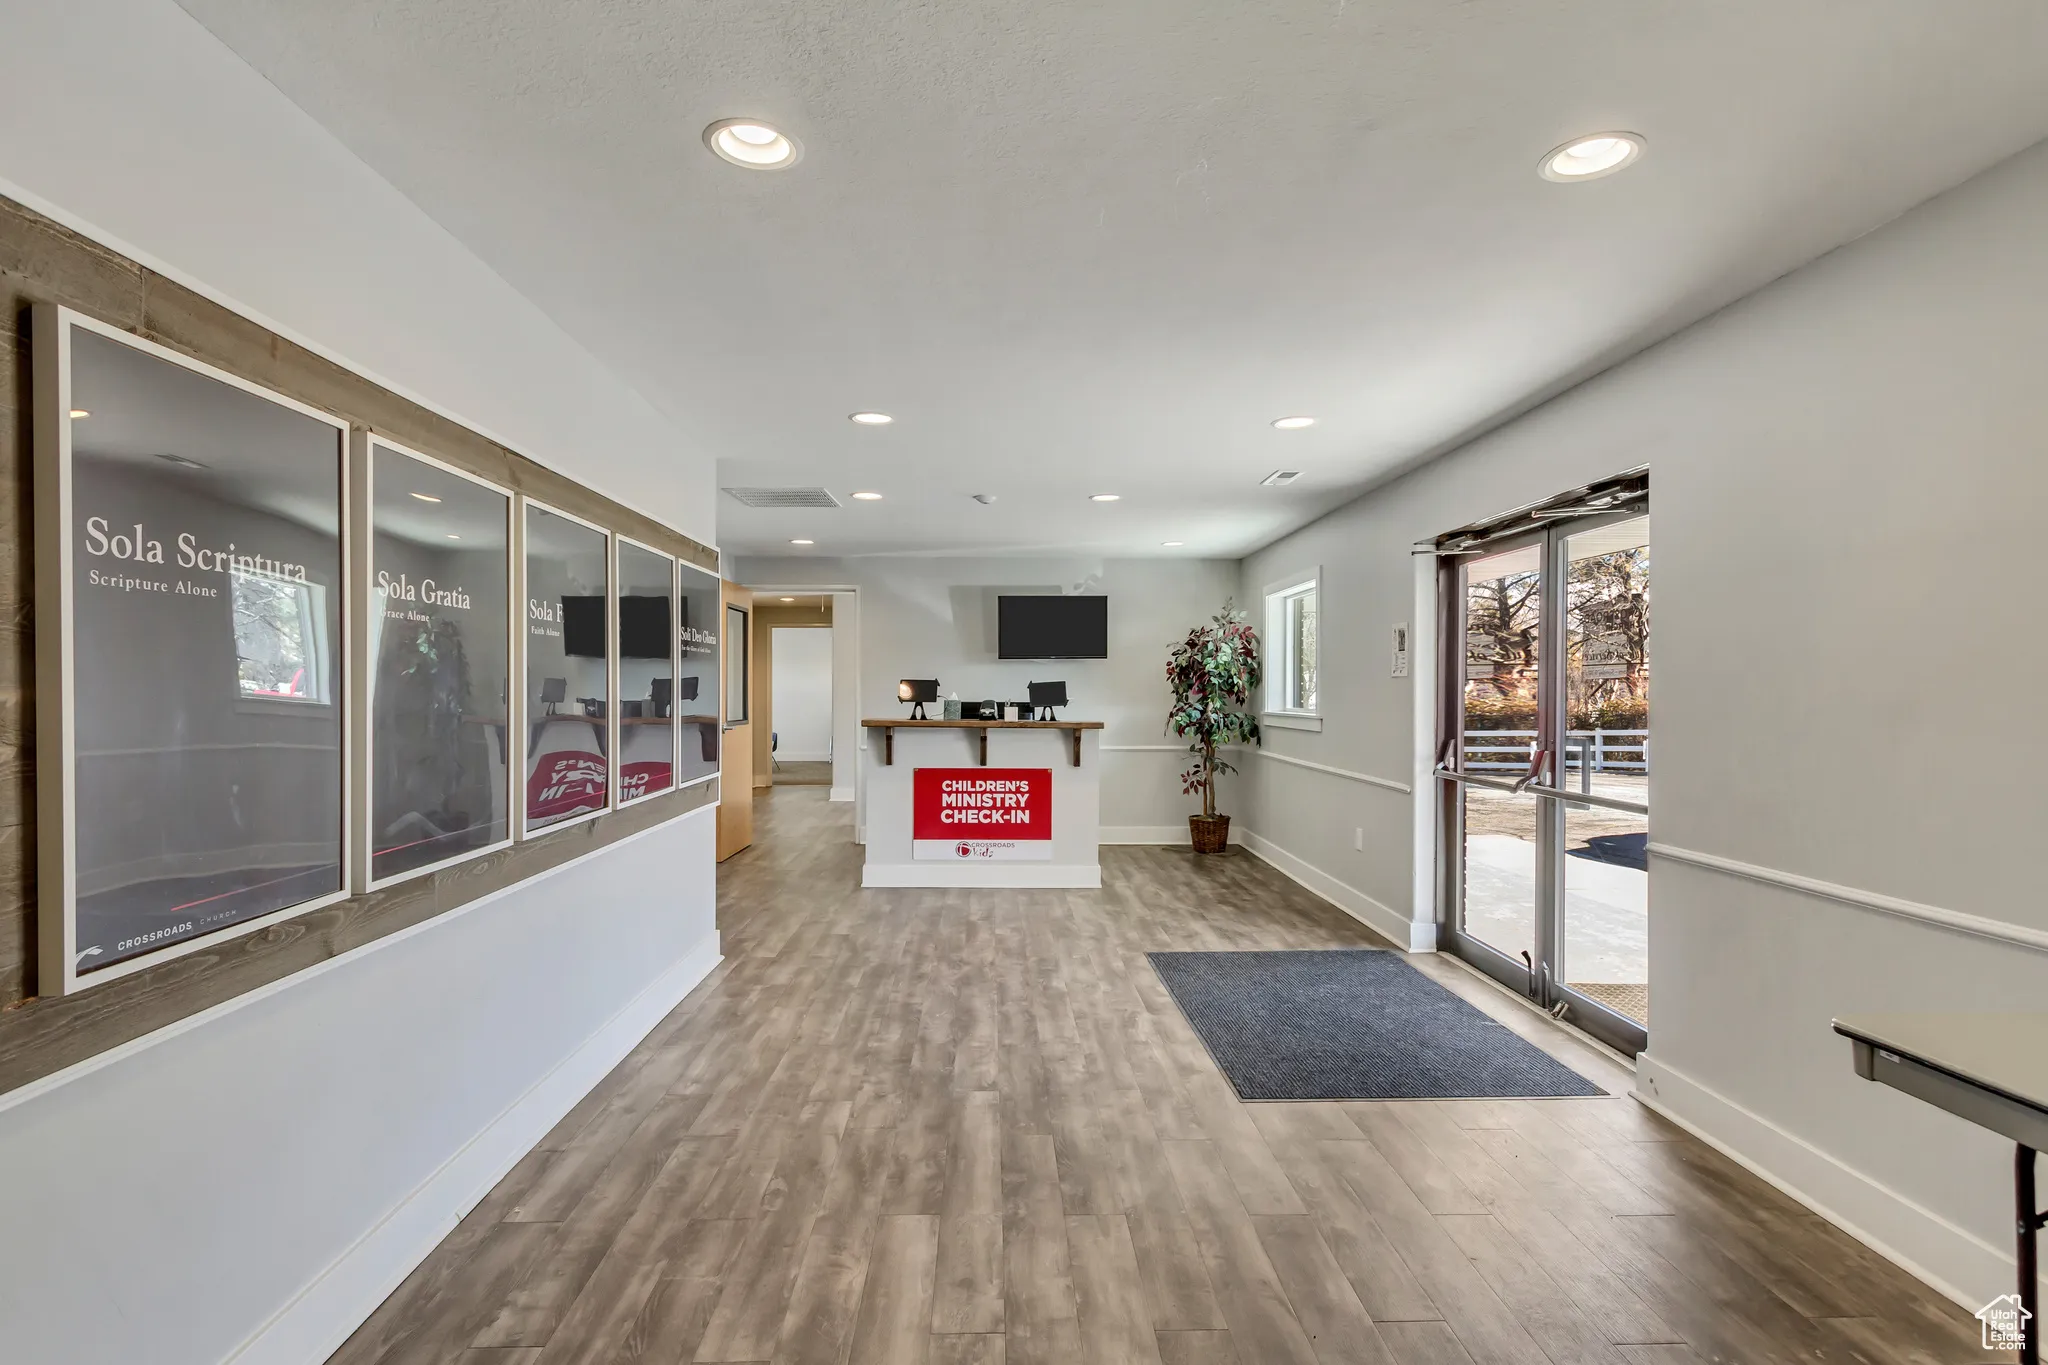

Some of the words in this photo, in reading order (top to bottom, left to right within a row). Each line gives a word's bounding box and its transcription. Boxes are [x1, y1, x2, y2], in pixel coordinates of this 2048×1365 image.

[85, 516, 164, 564] Sola
[176, 532, 306, 584] Scriptura
[89, 569, 168, 592] Scripture
[175, 580, 217, 597] Alone
[378, 570, 416, 602] Sola
[421, 579, 470, 609] Gratia
[380, 607, 404, 619] Grace
[407, 610, 430, 622] Alone
[530, 598, 553, 621] Sola
[942, 780, 1029, 792] CHILDREN'S
[941, 793, 1029, 807] MINISTRY
[940, 809, 1030, 824] CHECK-IN
[117, 921, 193, 951] CROSSROADS
[200, 909, 237, 925] CHURCH
